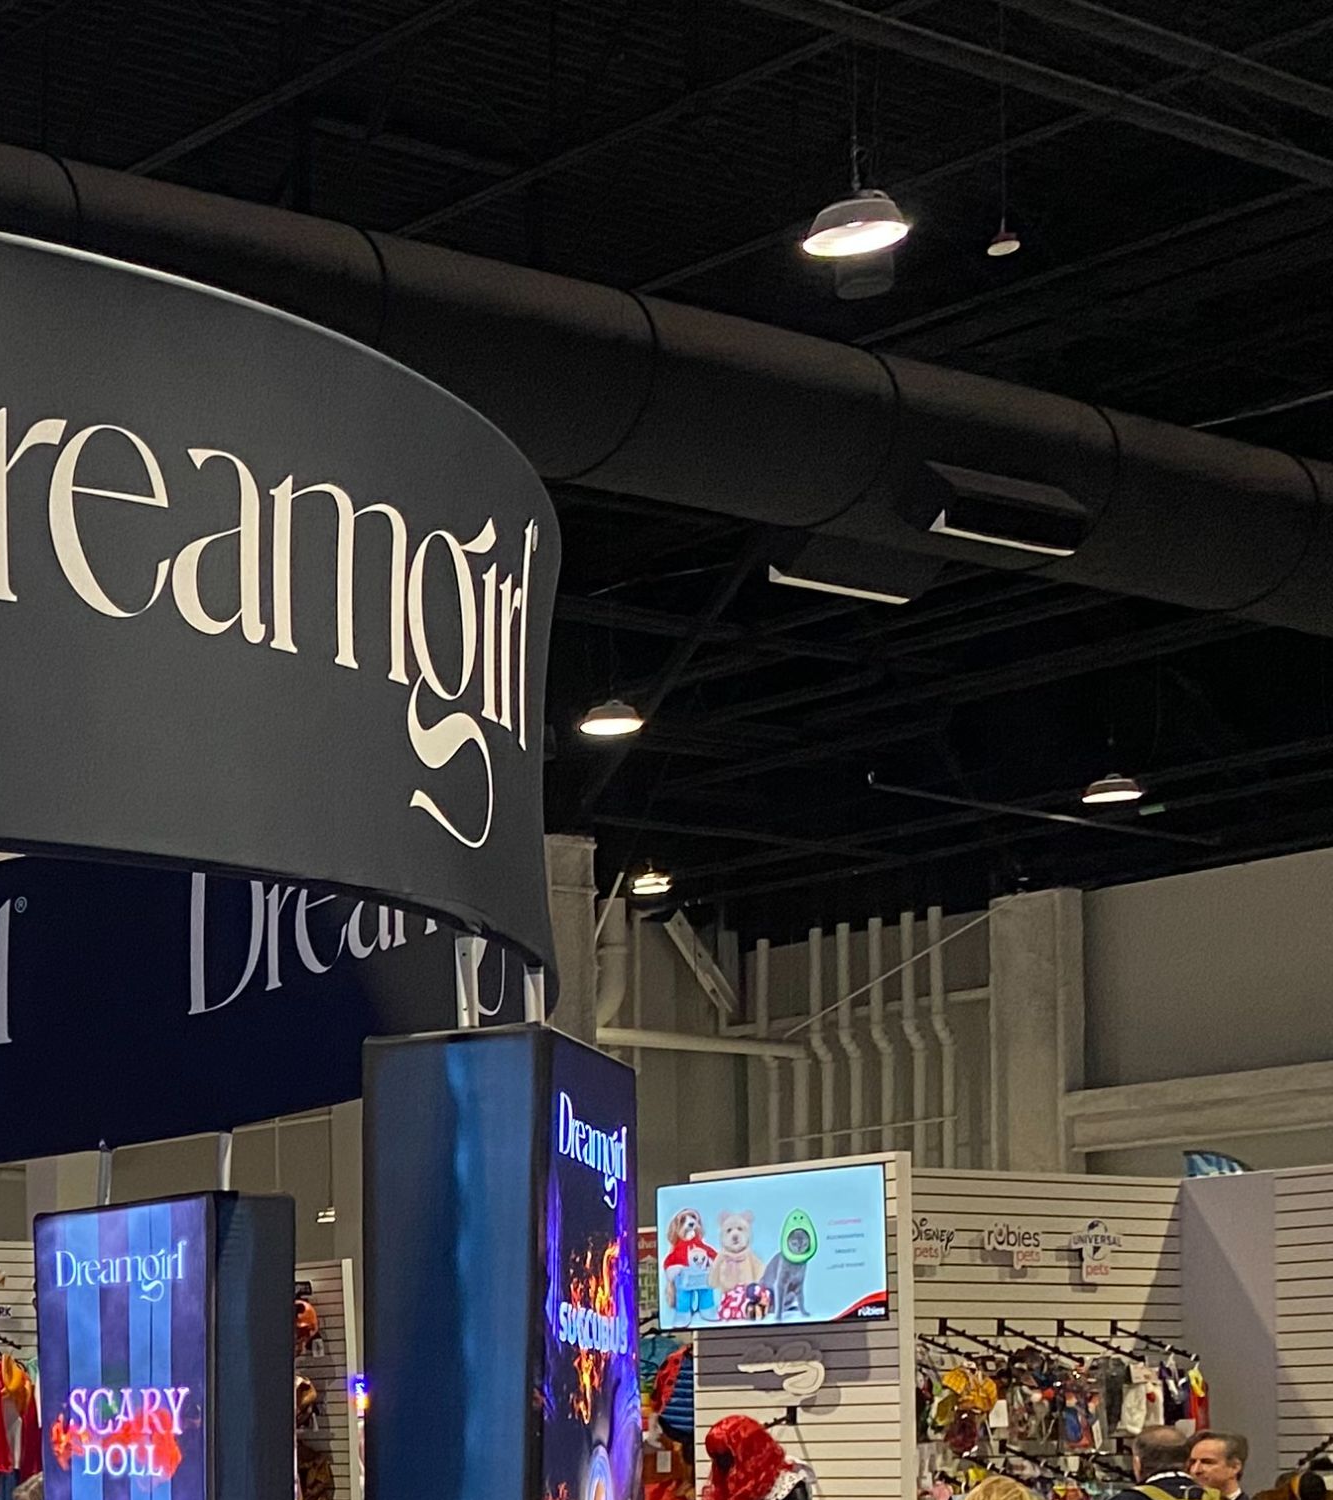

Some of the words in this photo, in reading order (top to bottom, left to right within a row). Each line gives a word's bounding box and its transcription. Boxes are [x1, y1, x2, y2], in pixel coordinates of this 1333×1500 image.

[1072, 1231, 1124, 1248] UNIVERSAL
[913, 1245, 939, 1260] pets
[1016, 1249, 1041, 1265] pets
[1085, 1263, 1110, 1279] pets
[559, 1301, 629, 1355] SUCCUBUS
[69, 1386, 190, 1435] SCARY
[83, 1443, 164, 1476] DOLL
